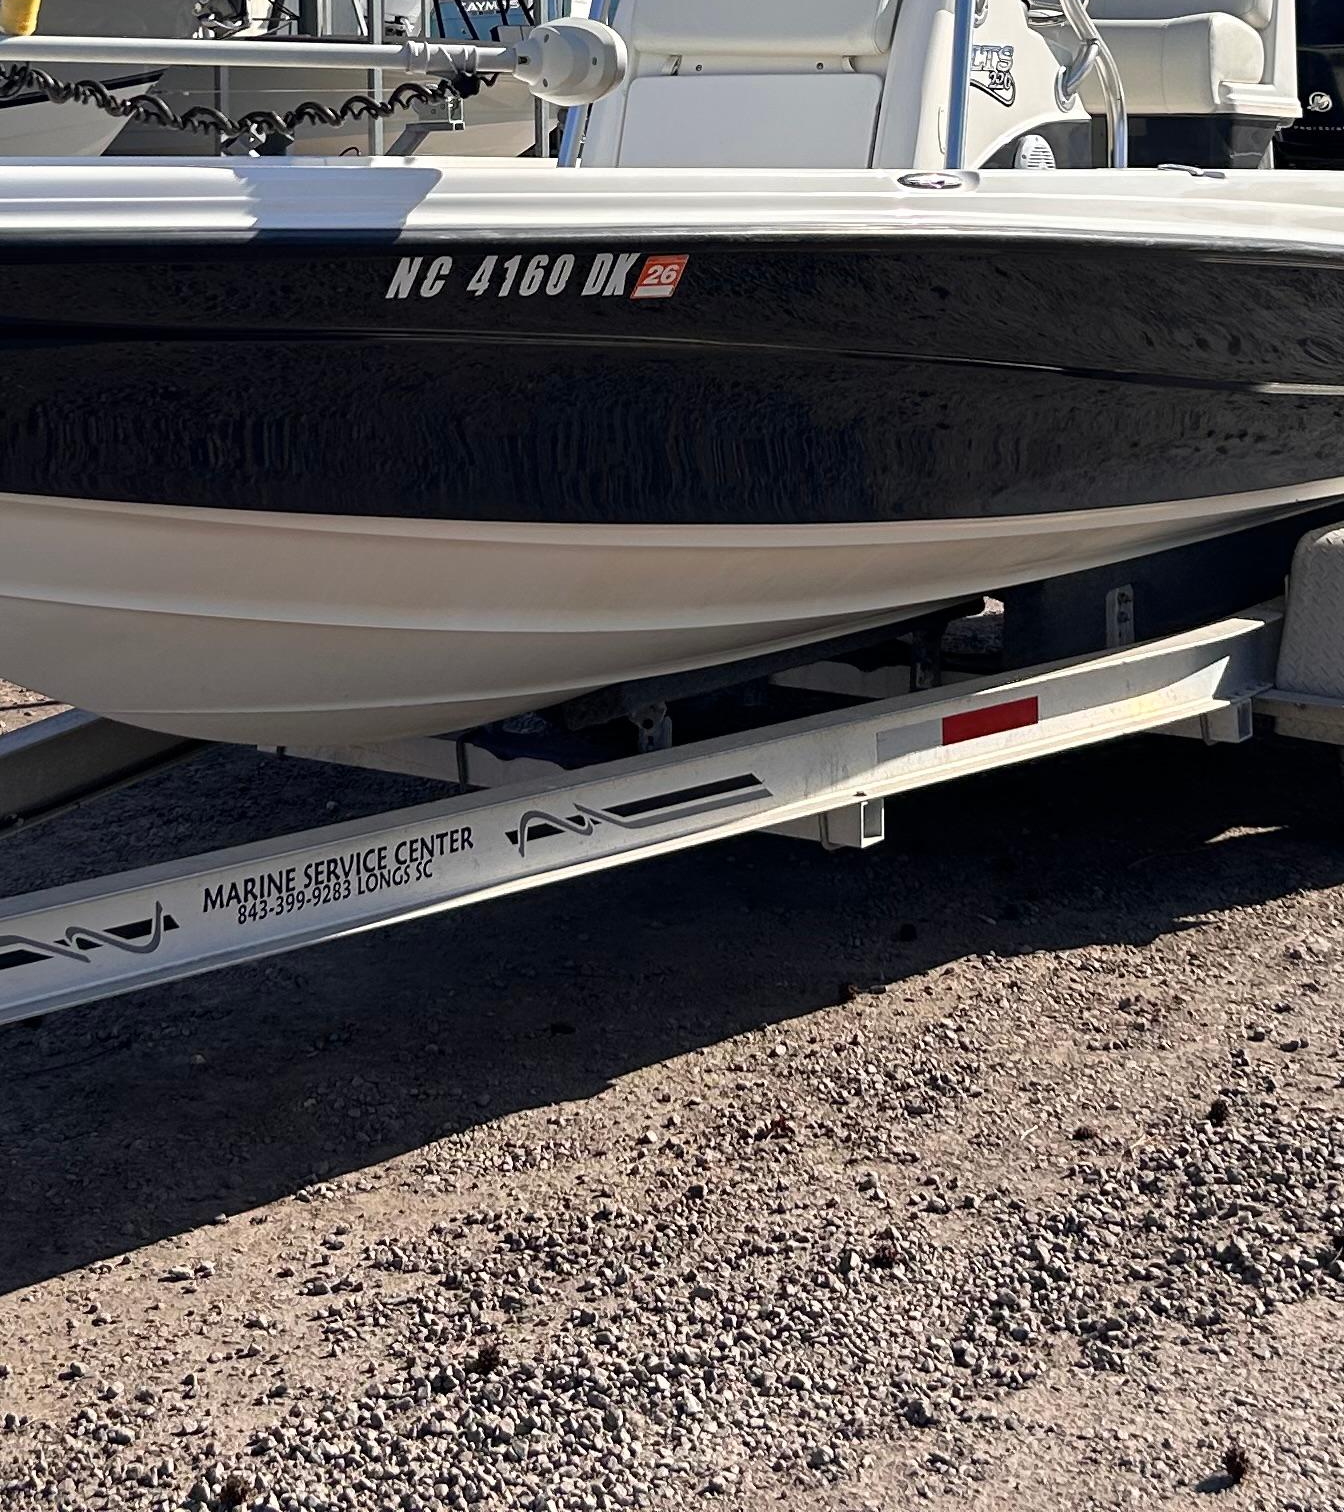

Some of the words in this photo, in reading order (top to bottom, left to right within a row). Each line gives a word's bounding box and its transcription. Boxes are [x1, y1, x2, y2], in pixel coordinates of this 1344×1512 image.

[987, 71, 1012, 90] 220
[385, 256, 453, 299] NC
[467, 254, 575, 296] 4160
[580, 252, 641, 296] DK
[641, 264, 680, 285] 26
[203, 867, 297, 913] MARINE
[303, 846, 388, 888] SERVICE
[394, 826, 474, 865] CENTER
[237, 879, 352, 925] 843-399-9283
[357, 863, 411, 895] LONGS
[415, 858, 433, 881] SC
